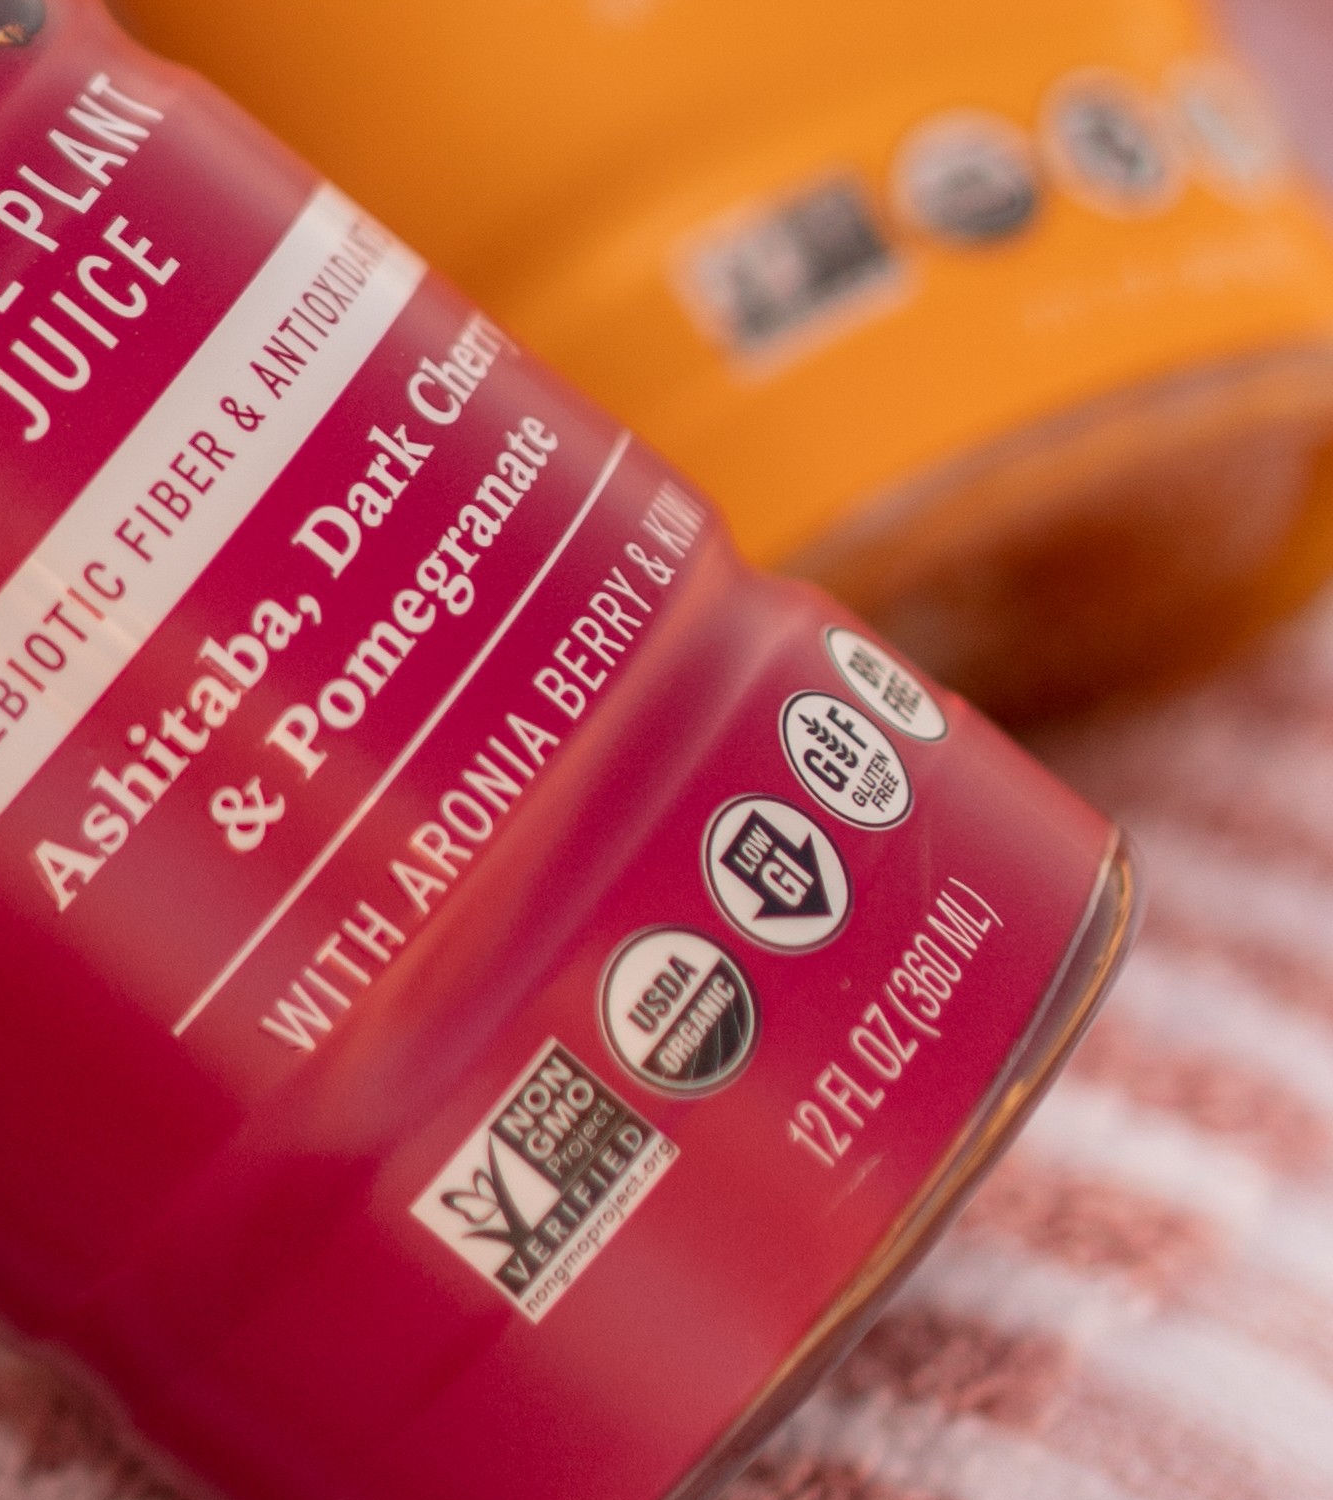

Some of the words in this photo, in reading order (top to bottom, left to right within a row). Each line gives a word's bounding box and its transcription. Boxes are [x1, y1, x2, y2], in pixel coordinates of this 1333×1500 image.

[113, 429, 237, 567] FIBER
[219, 395, 266, 433] &
[29, 592, 322, 912] Ashitaba,
[289, 423, 435, 579] Dark
[207, 781, 286, 856] &
[265, 413, 560, 782] Pomegranate
[260, 900, 408, 1058] WITH
[386, 713, 561, 922] ARONIA
[533, 564, 654, 720] BERRY
[624, 540, 674, 587] &
[850, 747, 893, 809] GLUTEN
[870, 773, 902, 813] FREE
[732, 823, 774, 877] LOW
[760, 846, 816, 909] GI
[927, 875, 1005, 962] ML)
[626, 953, 700, 1036] USDA
[654, 974, 736, 1075] ORGANIC
[883, 931, 965, 1040] (360
[848, 1001, 920, 1083] OZ
[497, 1055, 574, 1142] NON
[525, 1076, 596, 1161] GMO
[786, 1098, 853, 1168] 12
[814, 1061, 886, 1130] FL
[545, 1098, 616, 1180] Project
[504, 1123, 644, 1284] VERIFIED
[524, 1134, 679, 1314] nongmoproject.org
